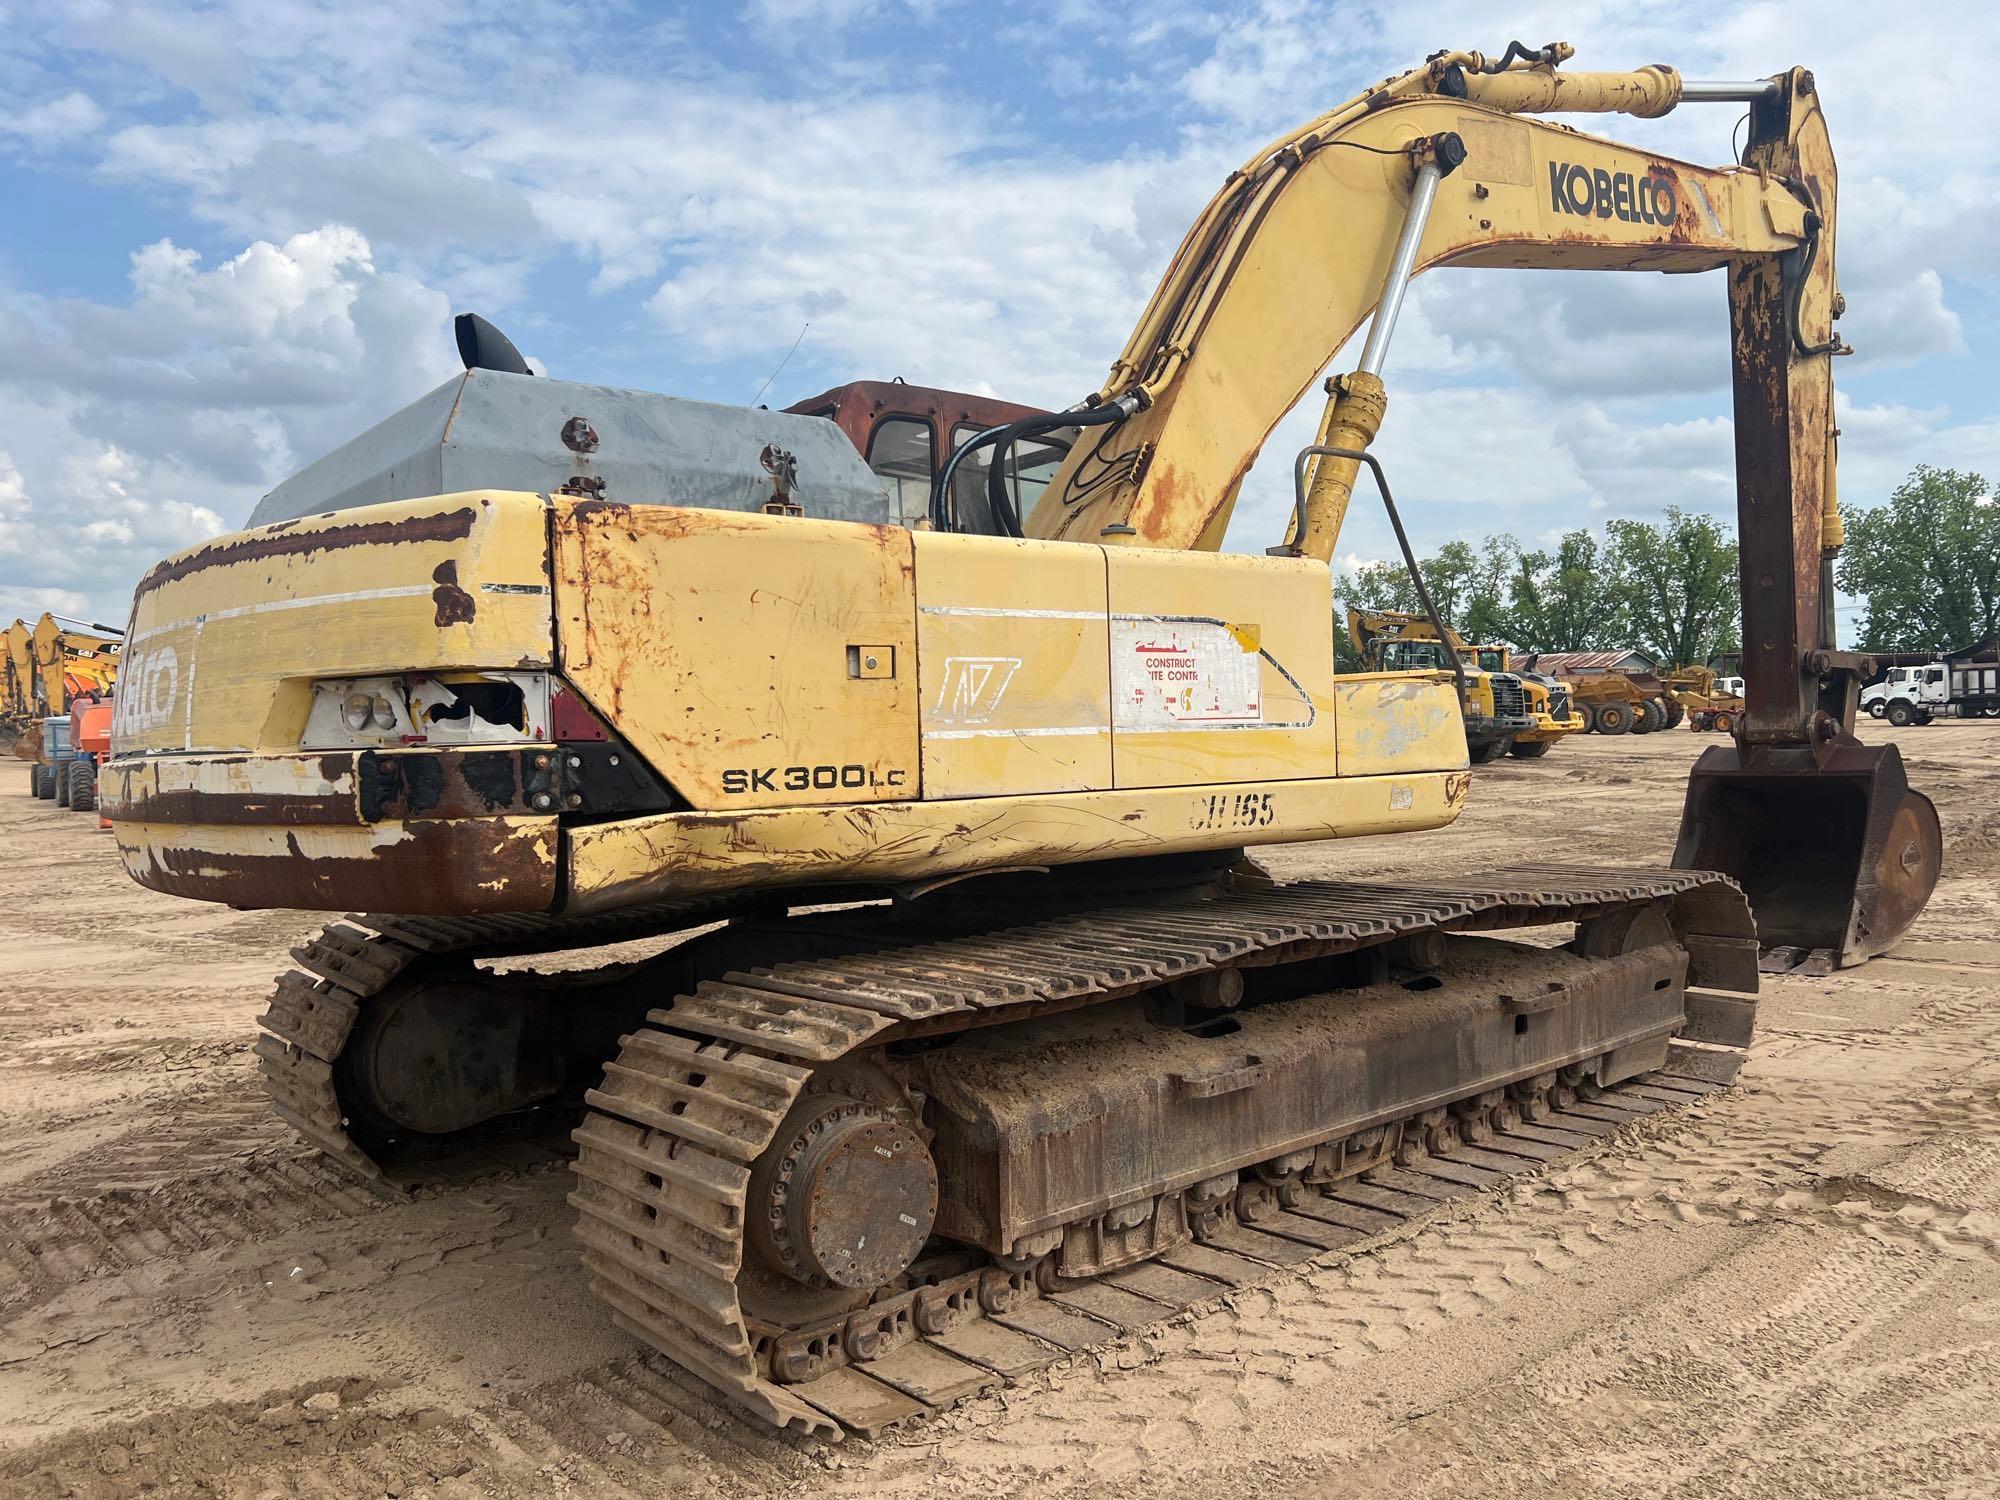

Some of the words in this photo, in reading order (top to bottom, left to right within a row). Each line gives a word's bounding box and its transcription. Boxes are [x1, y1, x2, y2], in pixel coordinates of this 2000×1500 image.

[1549, 160, 1677, 227] KOBELCO
[1146, 657, 1196, 669] CONSTRUCT
[1148, 671, 1164, 681] ITE
